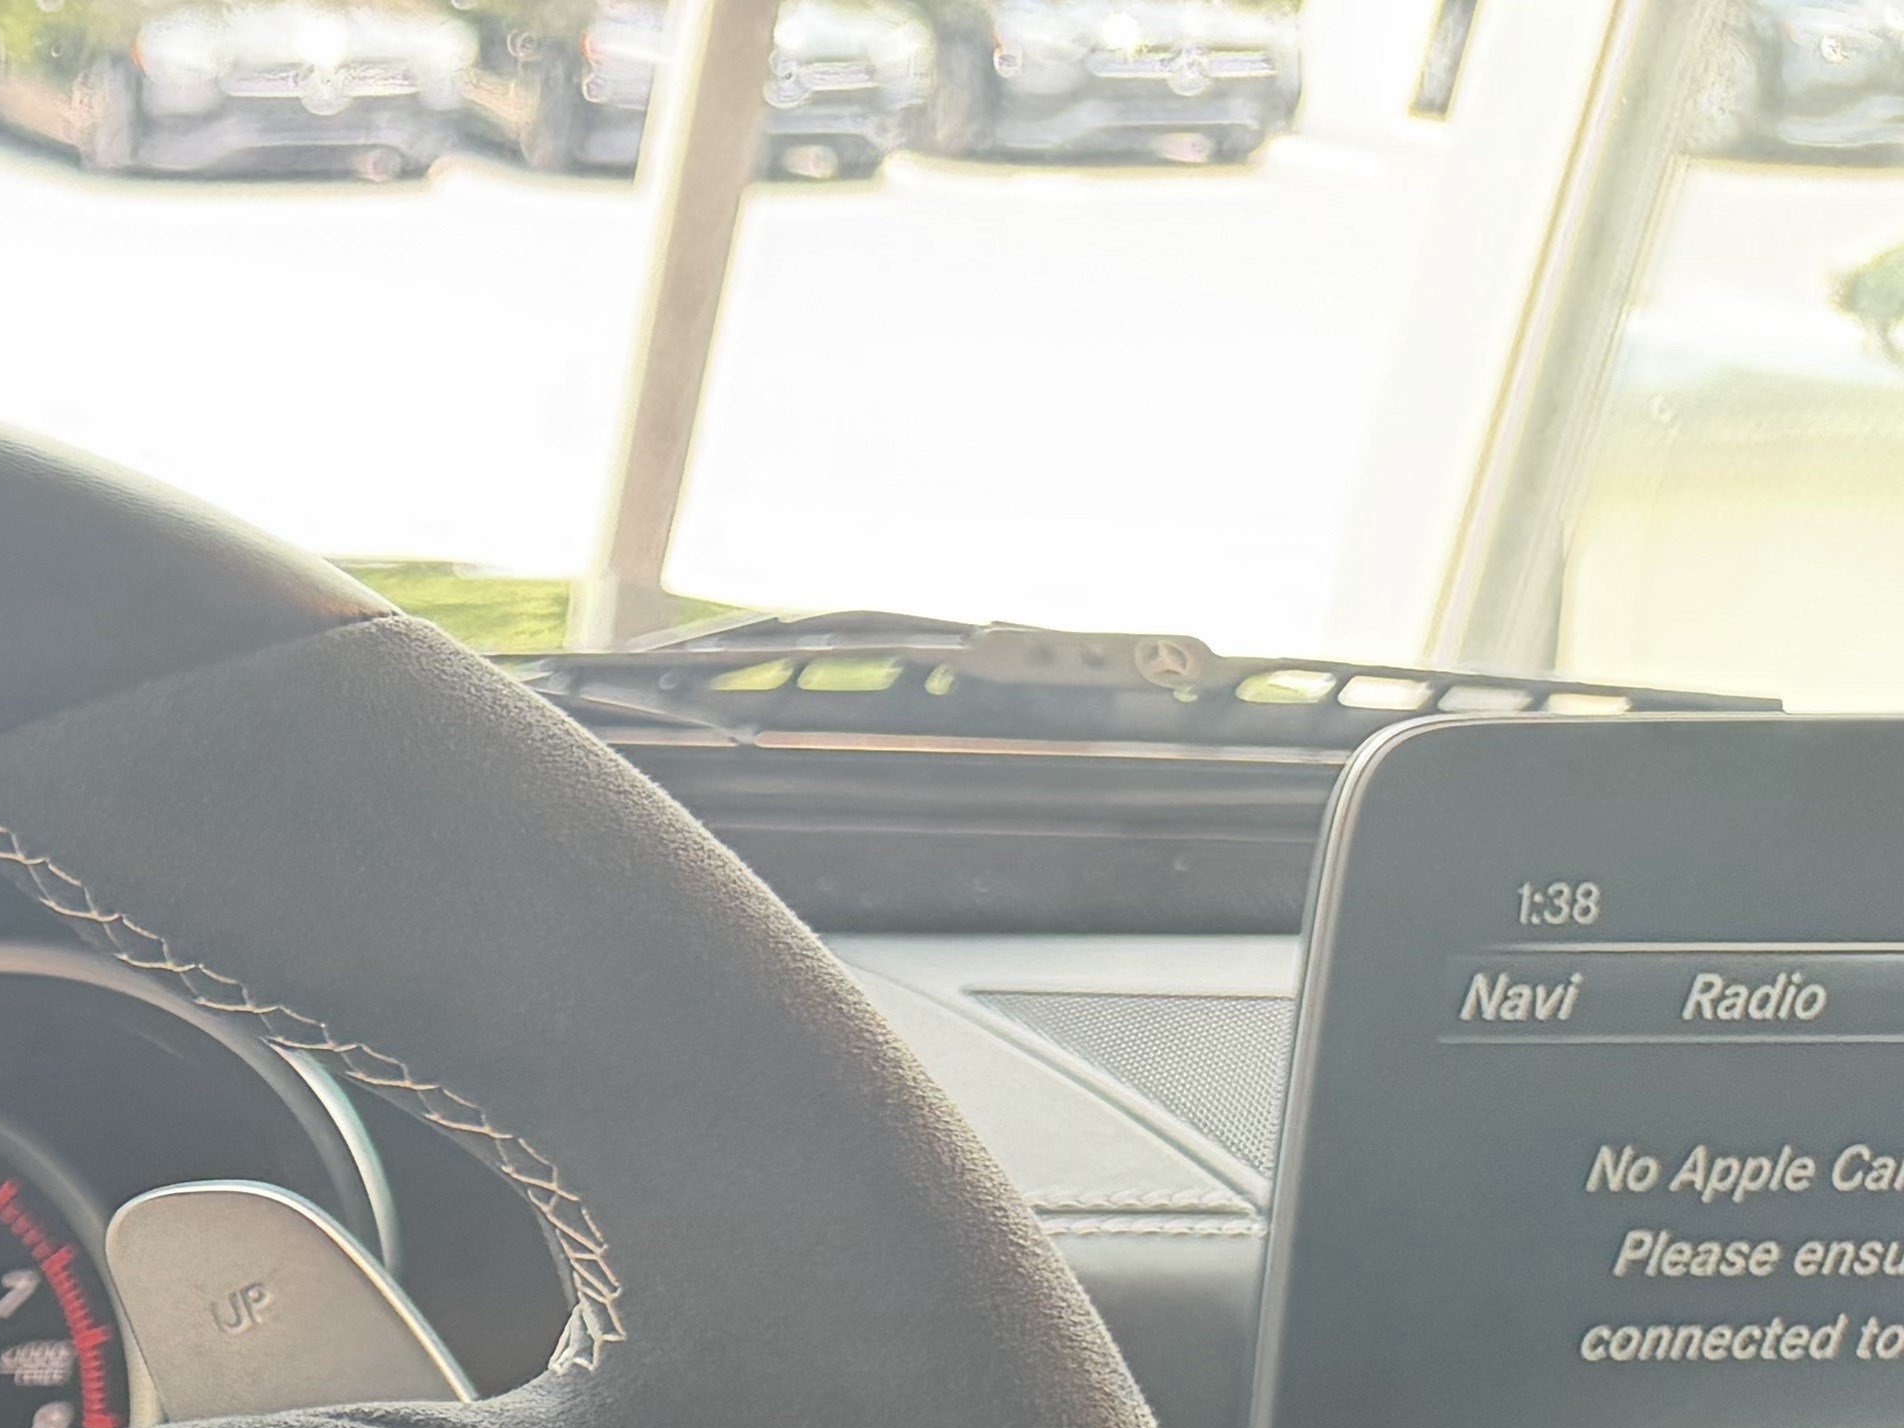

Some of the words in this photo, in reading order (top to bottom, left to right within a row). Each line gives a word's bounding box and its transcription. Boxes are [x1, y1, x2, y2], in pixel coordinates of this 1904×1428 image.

[1515, 880, 1602, 927] 1:38
[1460, 971, 1583, 1023] Navi
[1682, 971, 1828, 1022] Radio
[1585, 1144, 1658, 1193] No
[1670, 1144, 1815, 1204] Apple
[1614, 1230, 1780, 1279] Please
[210, 1281, 272, 1335] UP
[1580, 1312, 1850, 1361] connected
[1854, 1317, 1904, 1361] to
